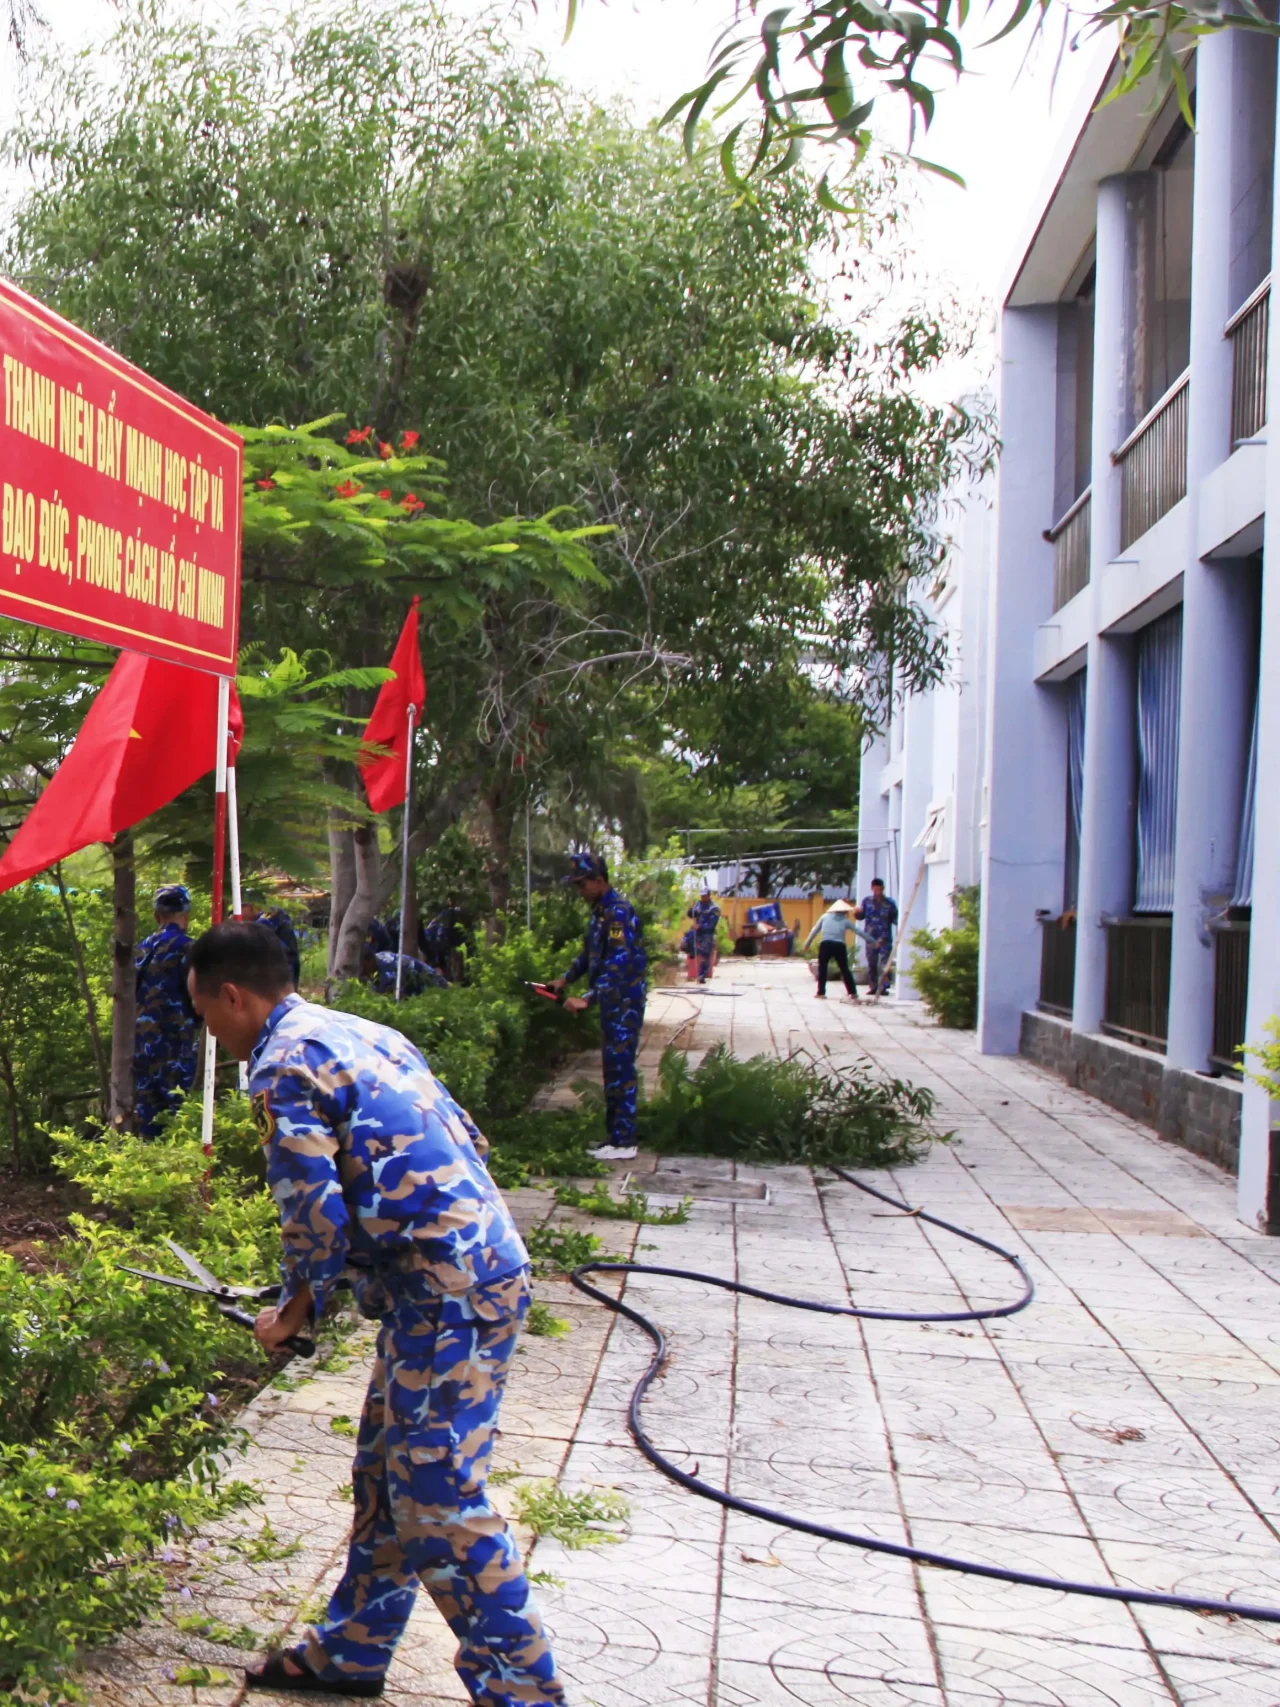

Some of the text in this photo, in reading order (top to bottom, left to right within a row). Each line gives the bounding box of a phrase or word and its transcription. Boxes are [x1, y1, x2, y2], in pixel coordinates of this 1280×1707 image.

[4, 354, 55, 449] THANH
[60, 382, 94, 467] NIÊN
[97, 390, 123, 481] ĐẨY
[126, 425, 162, 506] MẠNH
[165, 447, 187, 523] HỌC
[189, 454, 209, 534] TẬP
[211, 466, 224, 532] VÀ
[2, 483, 34, 575] ĐẠO
[39, 490, 73, 585] ĐỨC,
[76, 515, 122, 594] PHONG
[125, 527, 158, 605] CÁCH
[160, 534, 176, 612] HỒ
[177, 552, 197, 620] CHÍ
[198, 566, 225, 629] MINH
